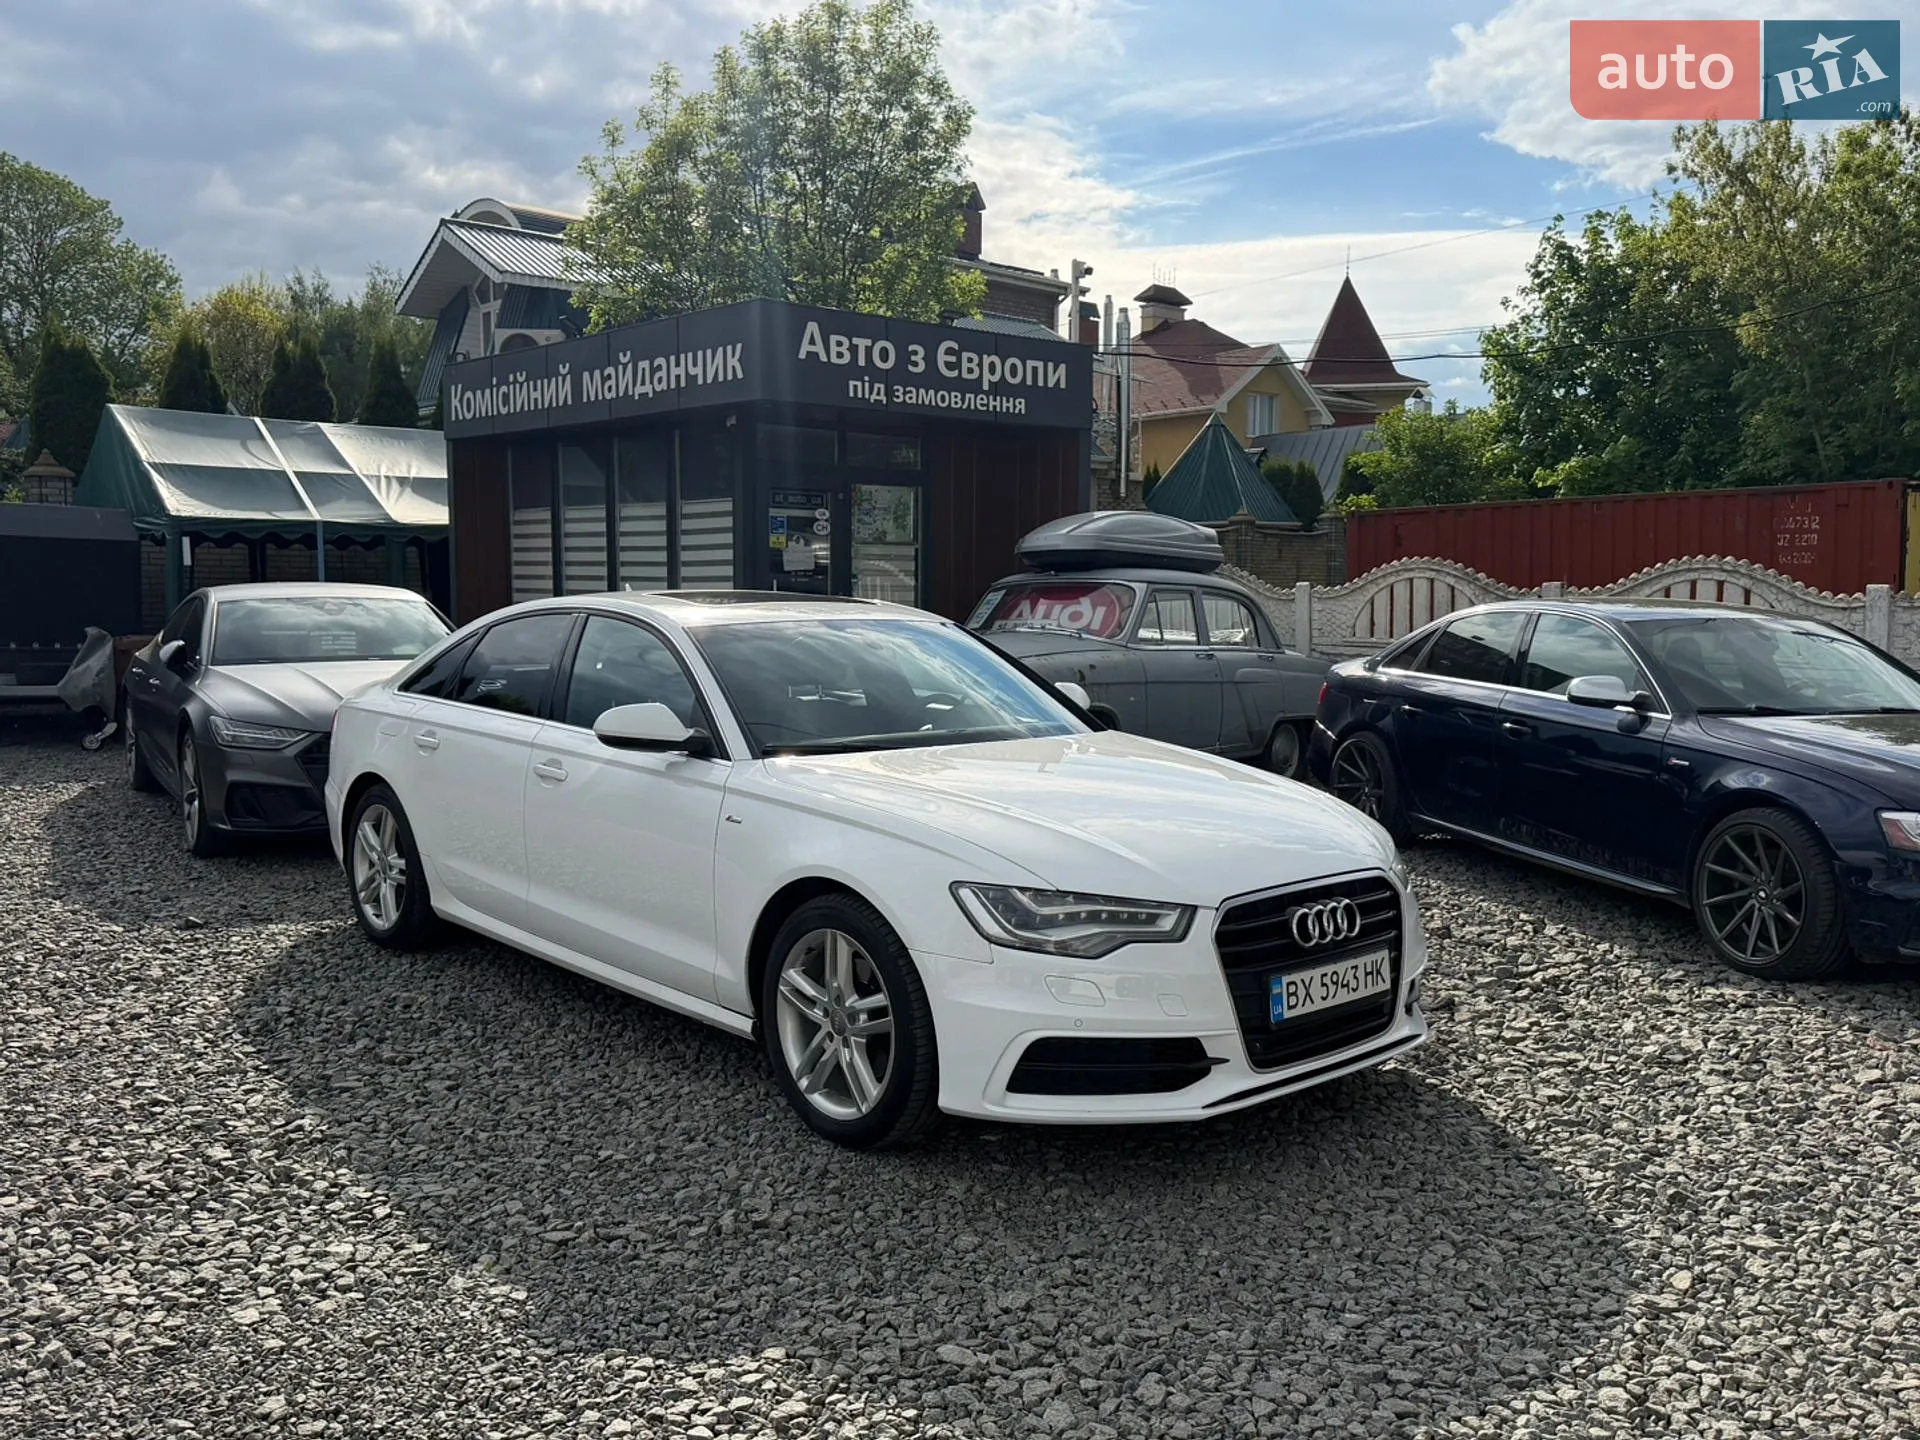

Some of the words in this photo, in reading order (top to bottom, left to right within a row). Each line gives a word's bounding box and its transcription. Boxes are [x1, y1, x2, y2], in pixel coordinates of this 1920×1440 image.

[451, 363, 572, 422] Комісійний
[582, 343, 744, 403] майданчик
[798, 321, 896, 371] Авто
[907, 344, 926, 374] з
[937, 340, 1068, 391] Європи
[848, 376, 887, 404] під
[892, 385, 1026, 415] замовлення
[815, 523, 828, 532] CH
[1286, 975, 1315, 1011] BX
[1320, 964, 1360, 1002] 5943
[1363, 957, 1387, 990] HK
